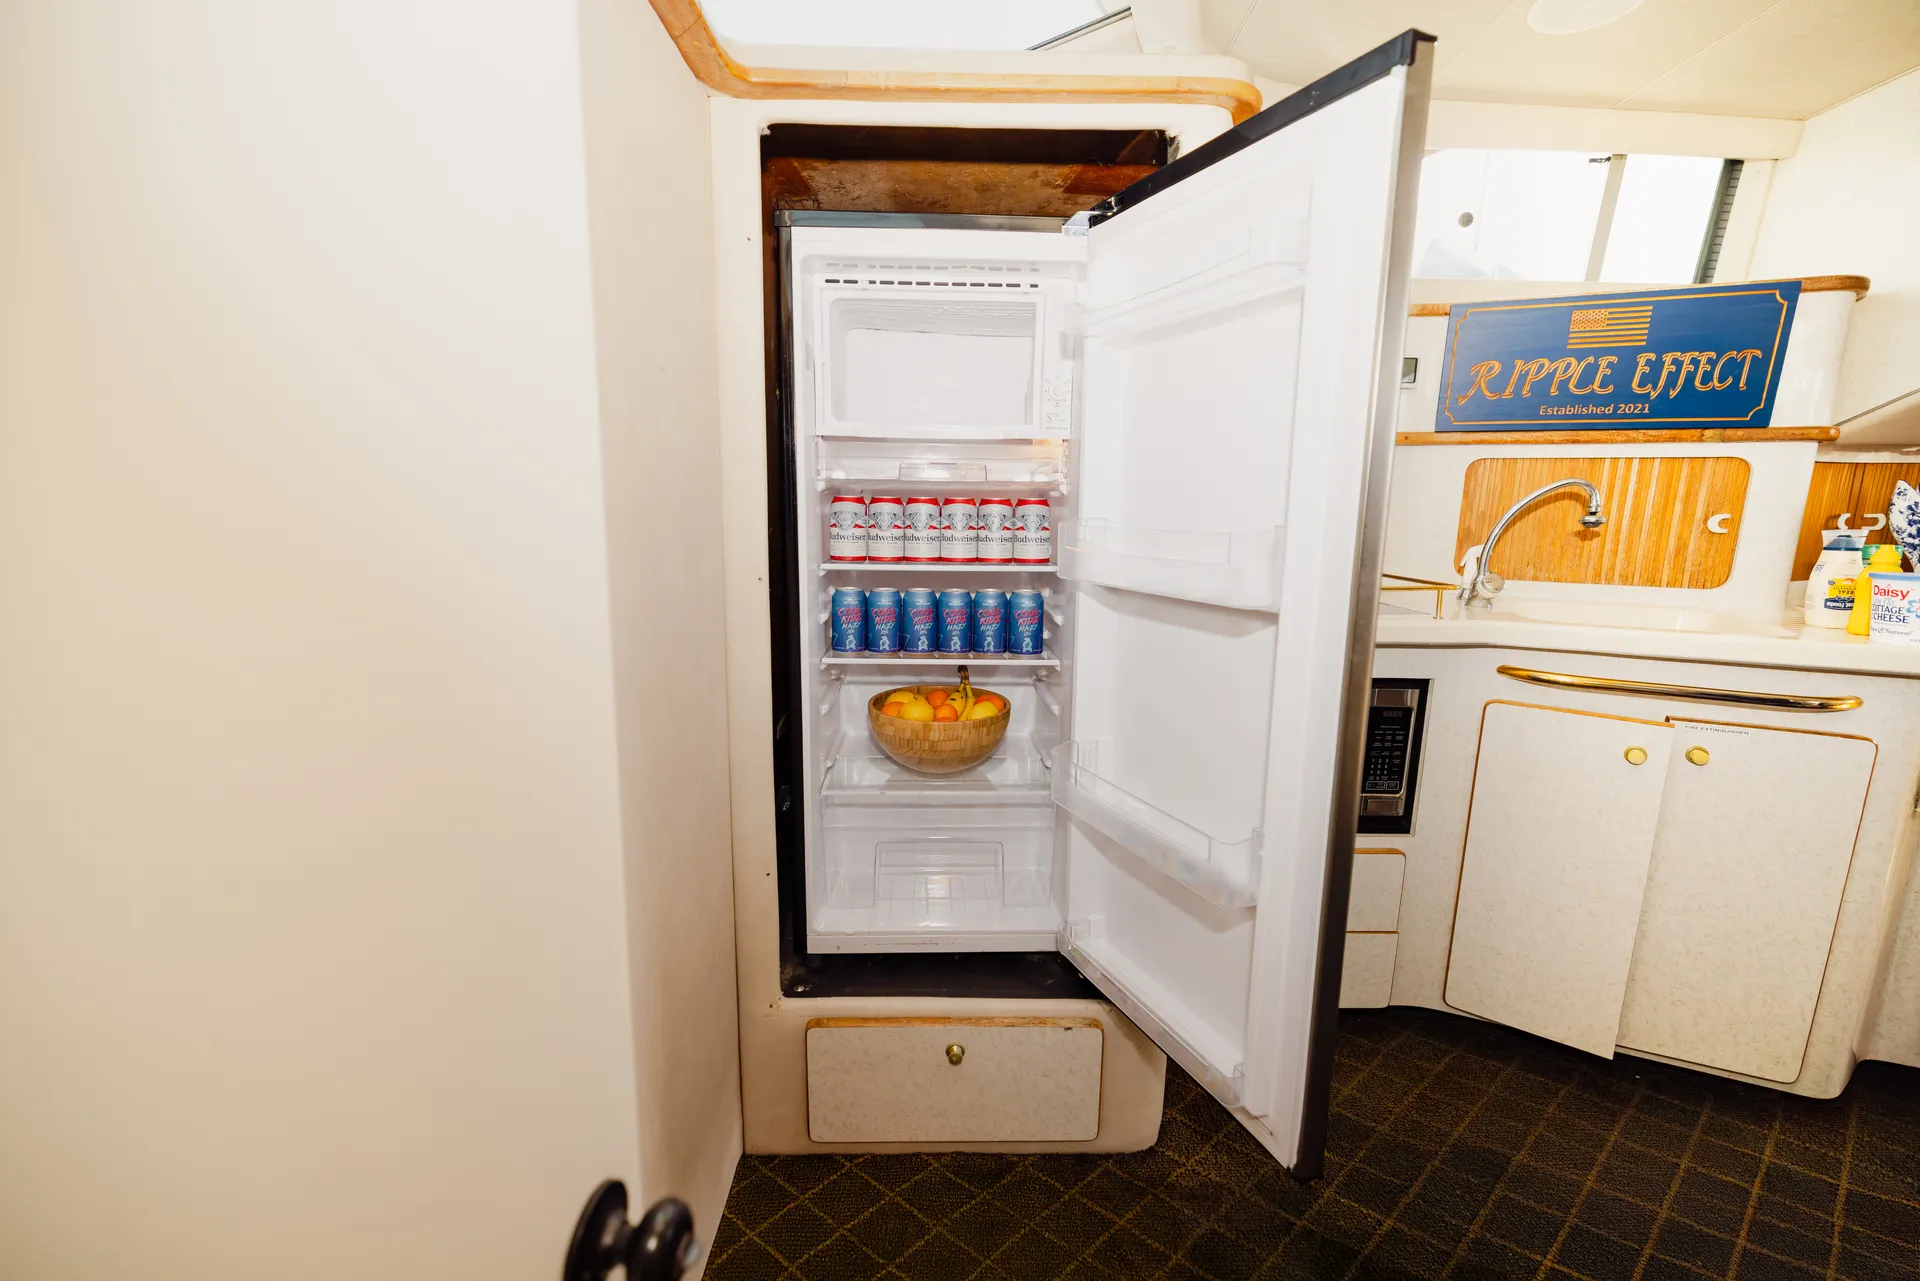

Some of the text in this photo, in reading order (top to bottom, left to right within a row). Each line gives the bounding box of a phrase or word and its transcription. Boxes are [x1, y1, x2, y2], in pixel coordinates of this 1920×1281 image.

[1631, 349, 1762, 400] EFFECT
[1539, 403, 1650, 416] Established 2021
[1874, 584, 1910, 601] Daisy
[841, 615, 862, 624] KIDZ
[874, 615, 896, 624] KIDZ
[913, 615, 933, 624] KIDZ
[946, 615, 967, 625] KIDZ
[980, 616, 1001, 625] KIDZ
[1018, 616, 1039, 626] KIDZ
[1874, 612, 1910, 624] CHEESE
[842, 622, 861, 630] HAZY
[876, 622, 895, 630] HAZY
[914, 622, 933, 630] HAZY
[947, 623, 966, 631] HAZY
[1019, 624, 1038, 632] HAZY
